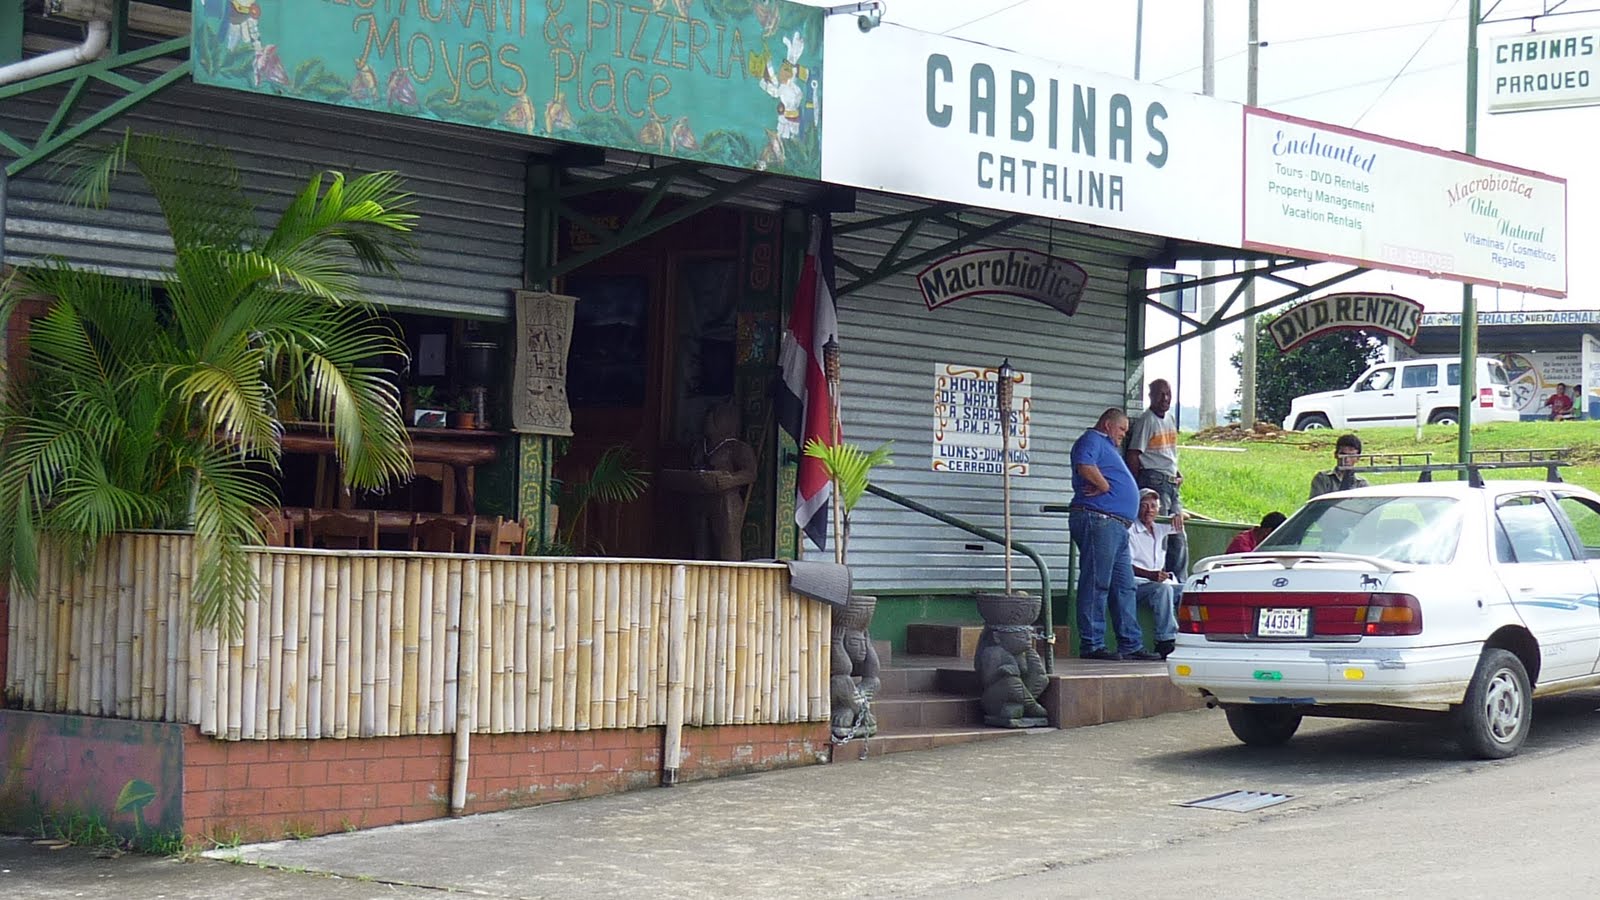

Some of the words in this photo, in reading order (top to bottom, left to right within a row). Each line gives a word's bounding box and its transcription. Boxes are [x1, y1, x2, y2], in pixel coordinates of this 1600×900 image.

[586, 0, 749, 79] PIZZERIA
[1496, 36, 1594, 64] CABINAS
[549, 47, 673, 124] Place
[1496, 70, 1590, 94] PARQUEO
[926, 53, 1169, 169] CABINAS
[1272, 130, 1376, 173] Enchanted
[977, 150, 1124, 212] CATALINA
[1275, 162, 1303, 179] Tours
[1310, 170, 1332, 185] DVD
[1334, 175, 1369, 193] Rentals
[1446, 173, 1533, 207] Macrobiotica
[1268, 181, 1313, 202] Property
[1315, 189, 1375, 213] Management
[1467, 196, 1499, 218] Vida
[1282, 203, 1325, 222] Vacation
[1327, 212, 1362, 230] Rentals
[1464, 232, 1505, 250] Vitaminas
[1497, 217, 1545, 243] Natural
[1491, 252, 1526, 270] Regalos
[1452, 313, 1524, 324] MERIALES
[1553, 312, 1594, 323] ARENAL
[950, 377, 999, 394] HORAR
[941, 390, 956, 404] DE
[964, 393, 999, 408] MART
[950, 405, 956, 418] A
[963, 407, 1018, 423] SABADS
[983, 421, 989, 434] A
[948, 460, 1002, 473] CERRADO
[1264, 614, 1302, 630] 443641
